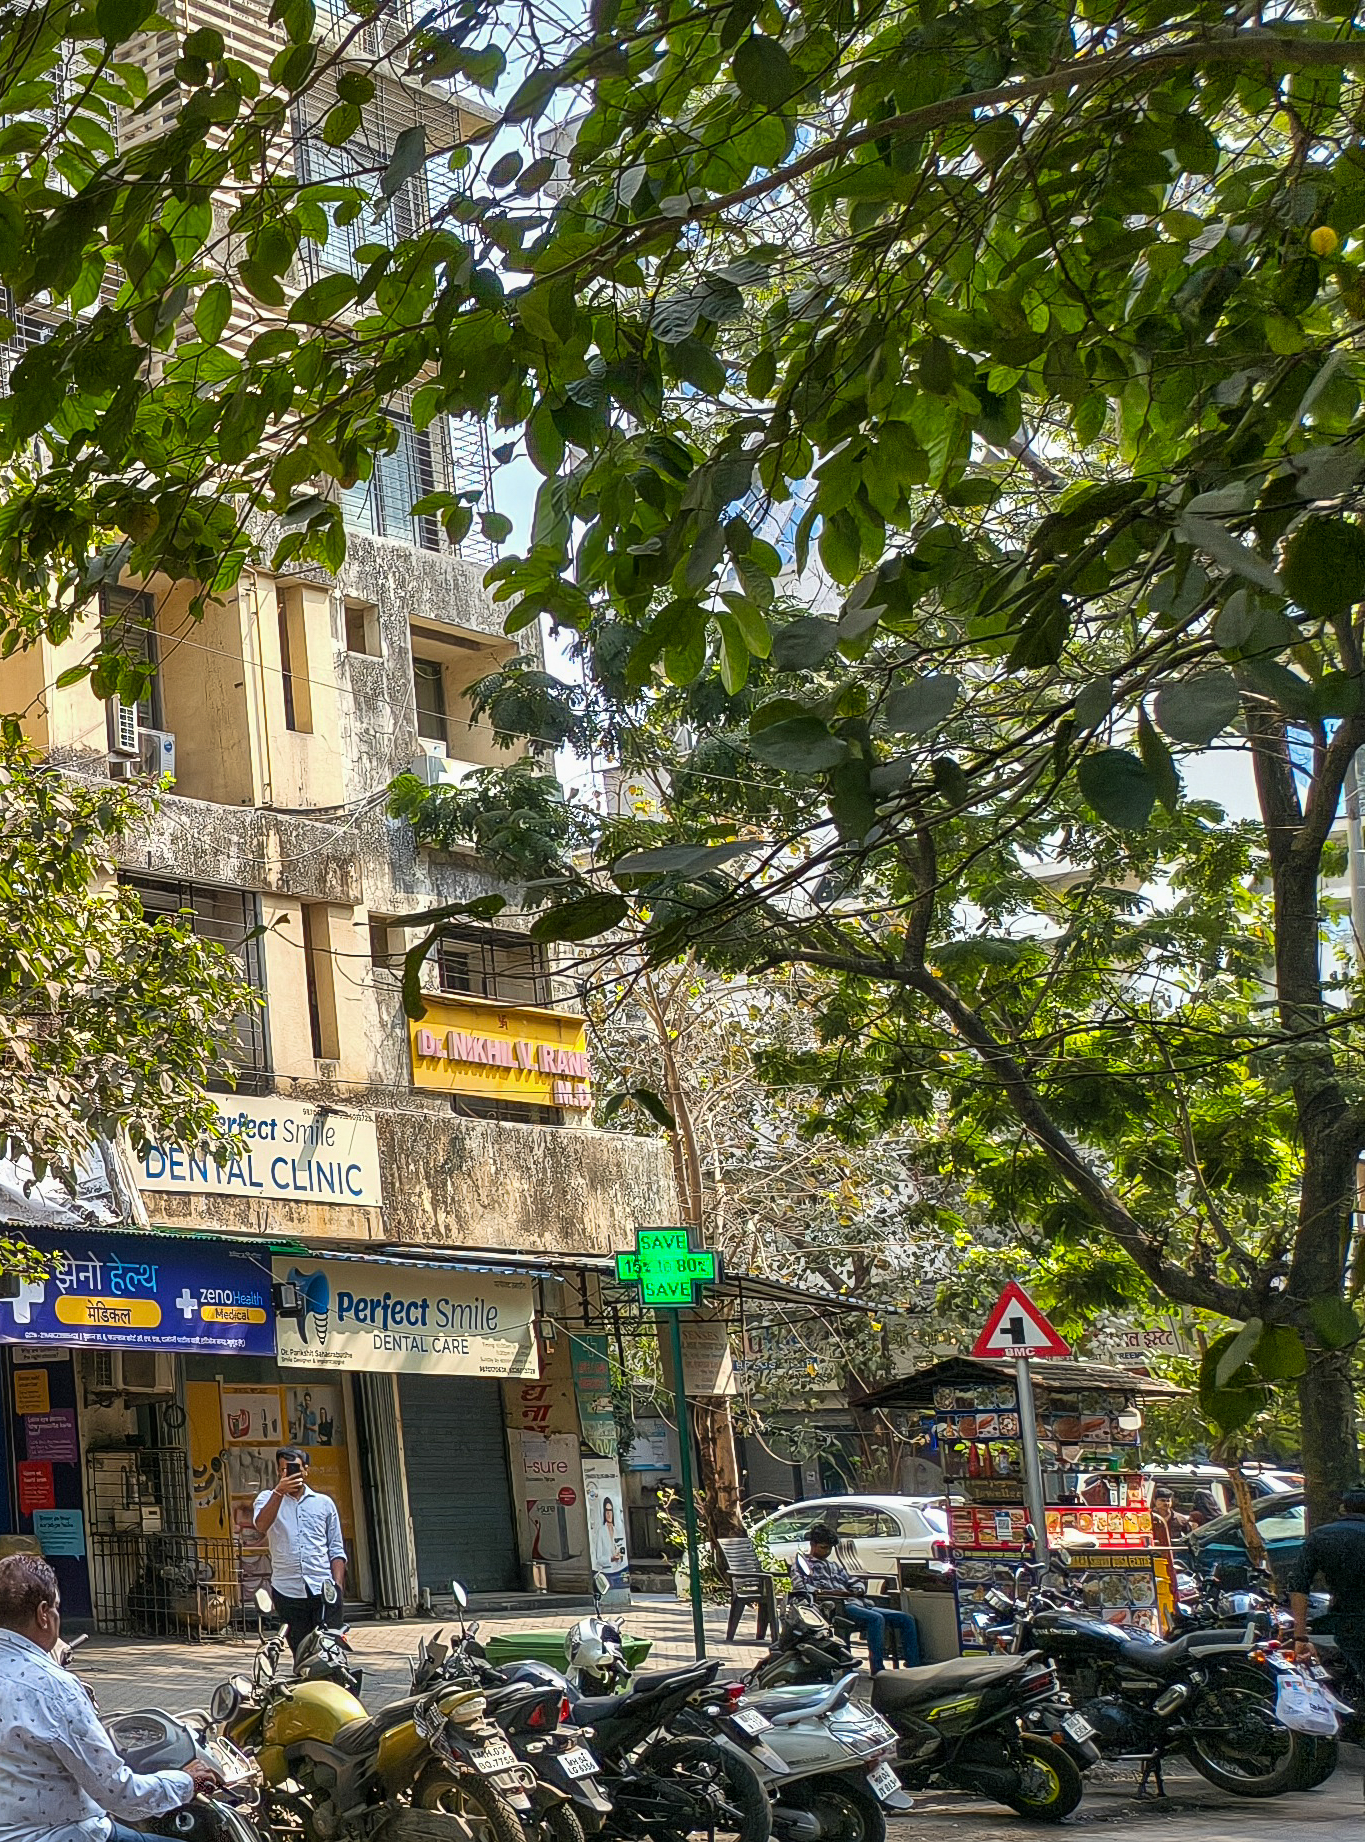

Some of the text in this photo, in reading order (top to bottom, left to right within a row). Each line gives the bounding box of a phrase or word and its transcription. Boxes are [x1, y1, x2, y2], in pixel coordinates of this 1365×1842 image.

[448, 1031, 591, 1079] NIKHIL V. RANE
[282, 1119, 336, 1147] Smile
[270, 1157, 363, 1197] CLINIC
[641, 1234, 686, 1250] SAVE
[55, 1250, 158, 1294] झेनो हेल्थ
[677, 1258, 706, 1273] 80%
[646, 1282, 691, 1297] SAVE
[86, 1300, 132, 1325] मेडिकल
[215, 1308, 249, 1321] Medical
[337, 1291, 498, 1331] Perfect Smile
[373, 1335, 470, 1355] DENTAL CARE
[1005, 1347, 1036, 1357] BMC
